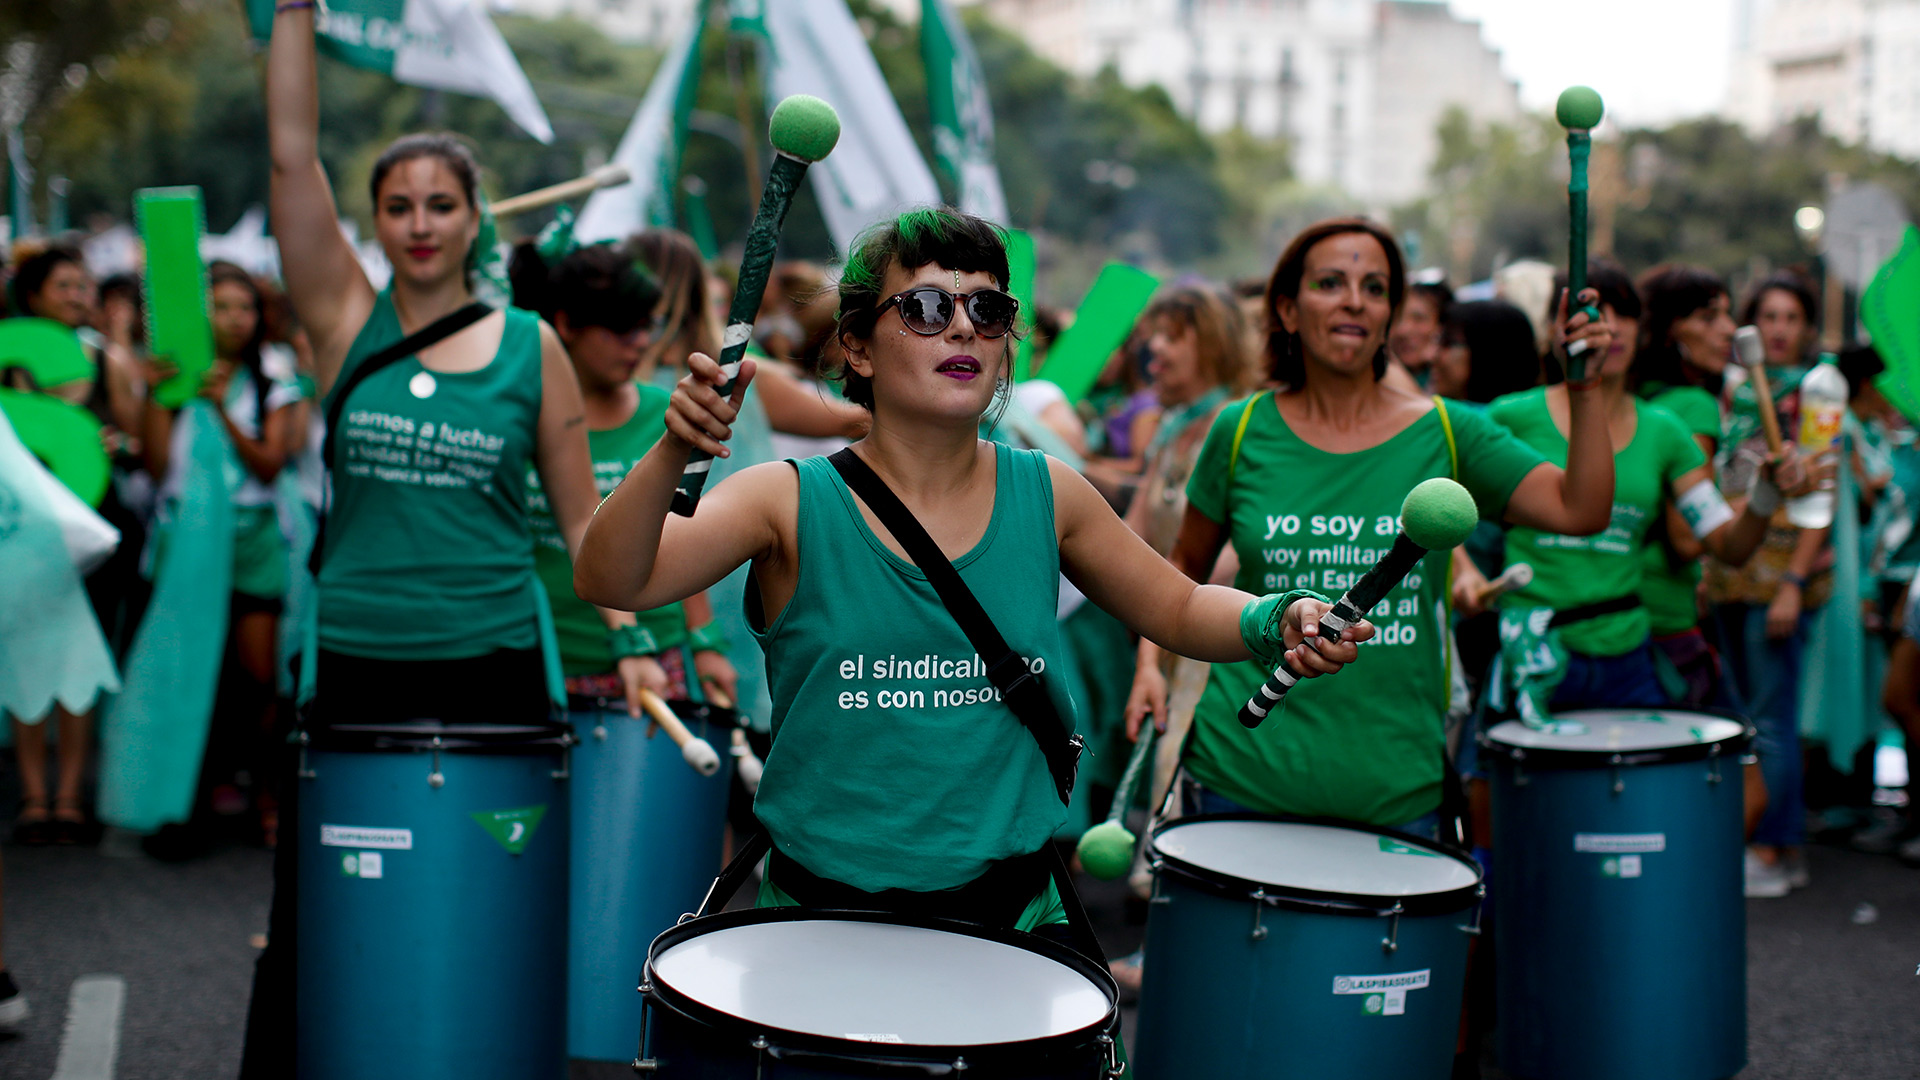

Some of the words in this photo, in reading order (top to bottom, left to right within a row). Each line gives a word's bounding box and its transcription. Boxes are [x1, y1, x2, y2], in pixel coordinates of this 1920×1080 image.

[419, 421, 436, 439] a
[439, 421, 505, 451] luchar
[1264, 514, 1301, 541] yo
[1310, 514, 1365, 541] soy
[1374, 515, 1405, 535] as
[1263, 548, 1301, 569] voy
[1264, 573, 1290, 589] en
[1296, 571, 1316, 588] el
[1397, 595, 1419, 616] al
[839, 654, 863, 680] el
[872, 653, 1046, 680] sindicalio
[838, 690, 869, 710] es
[877, 689, 925, 709] con
